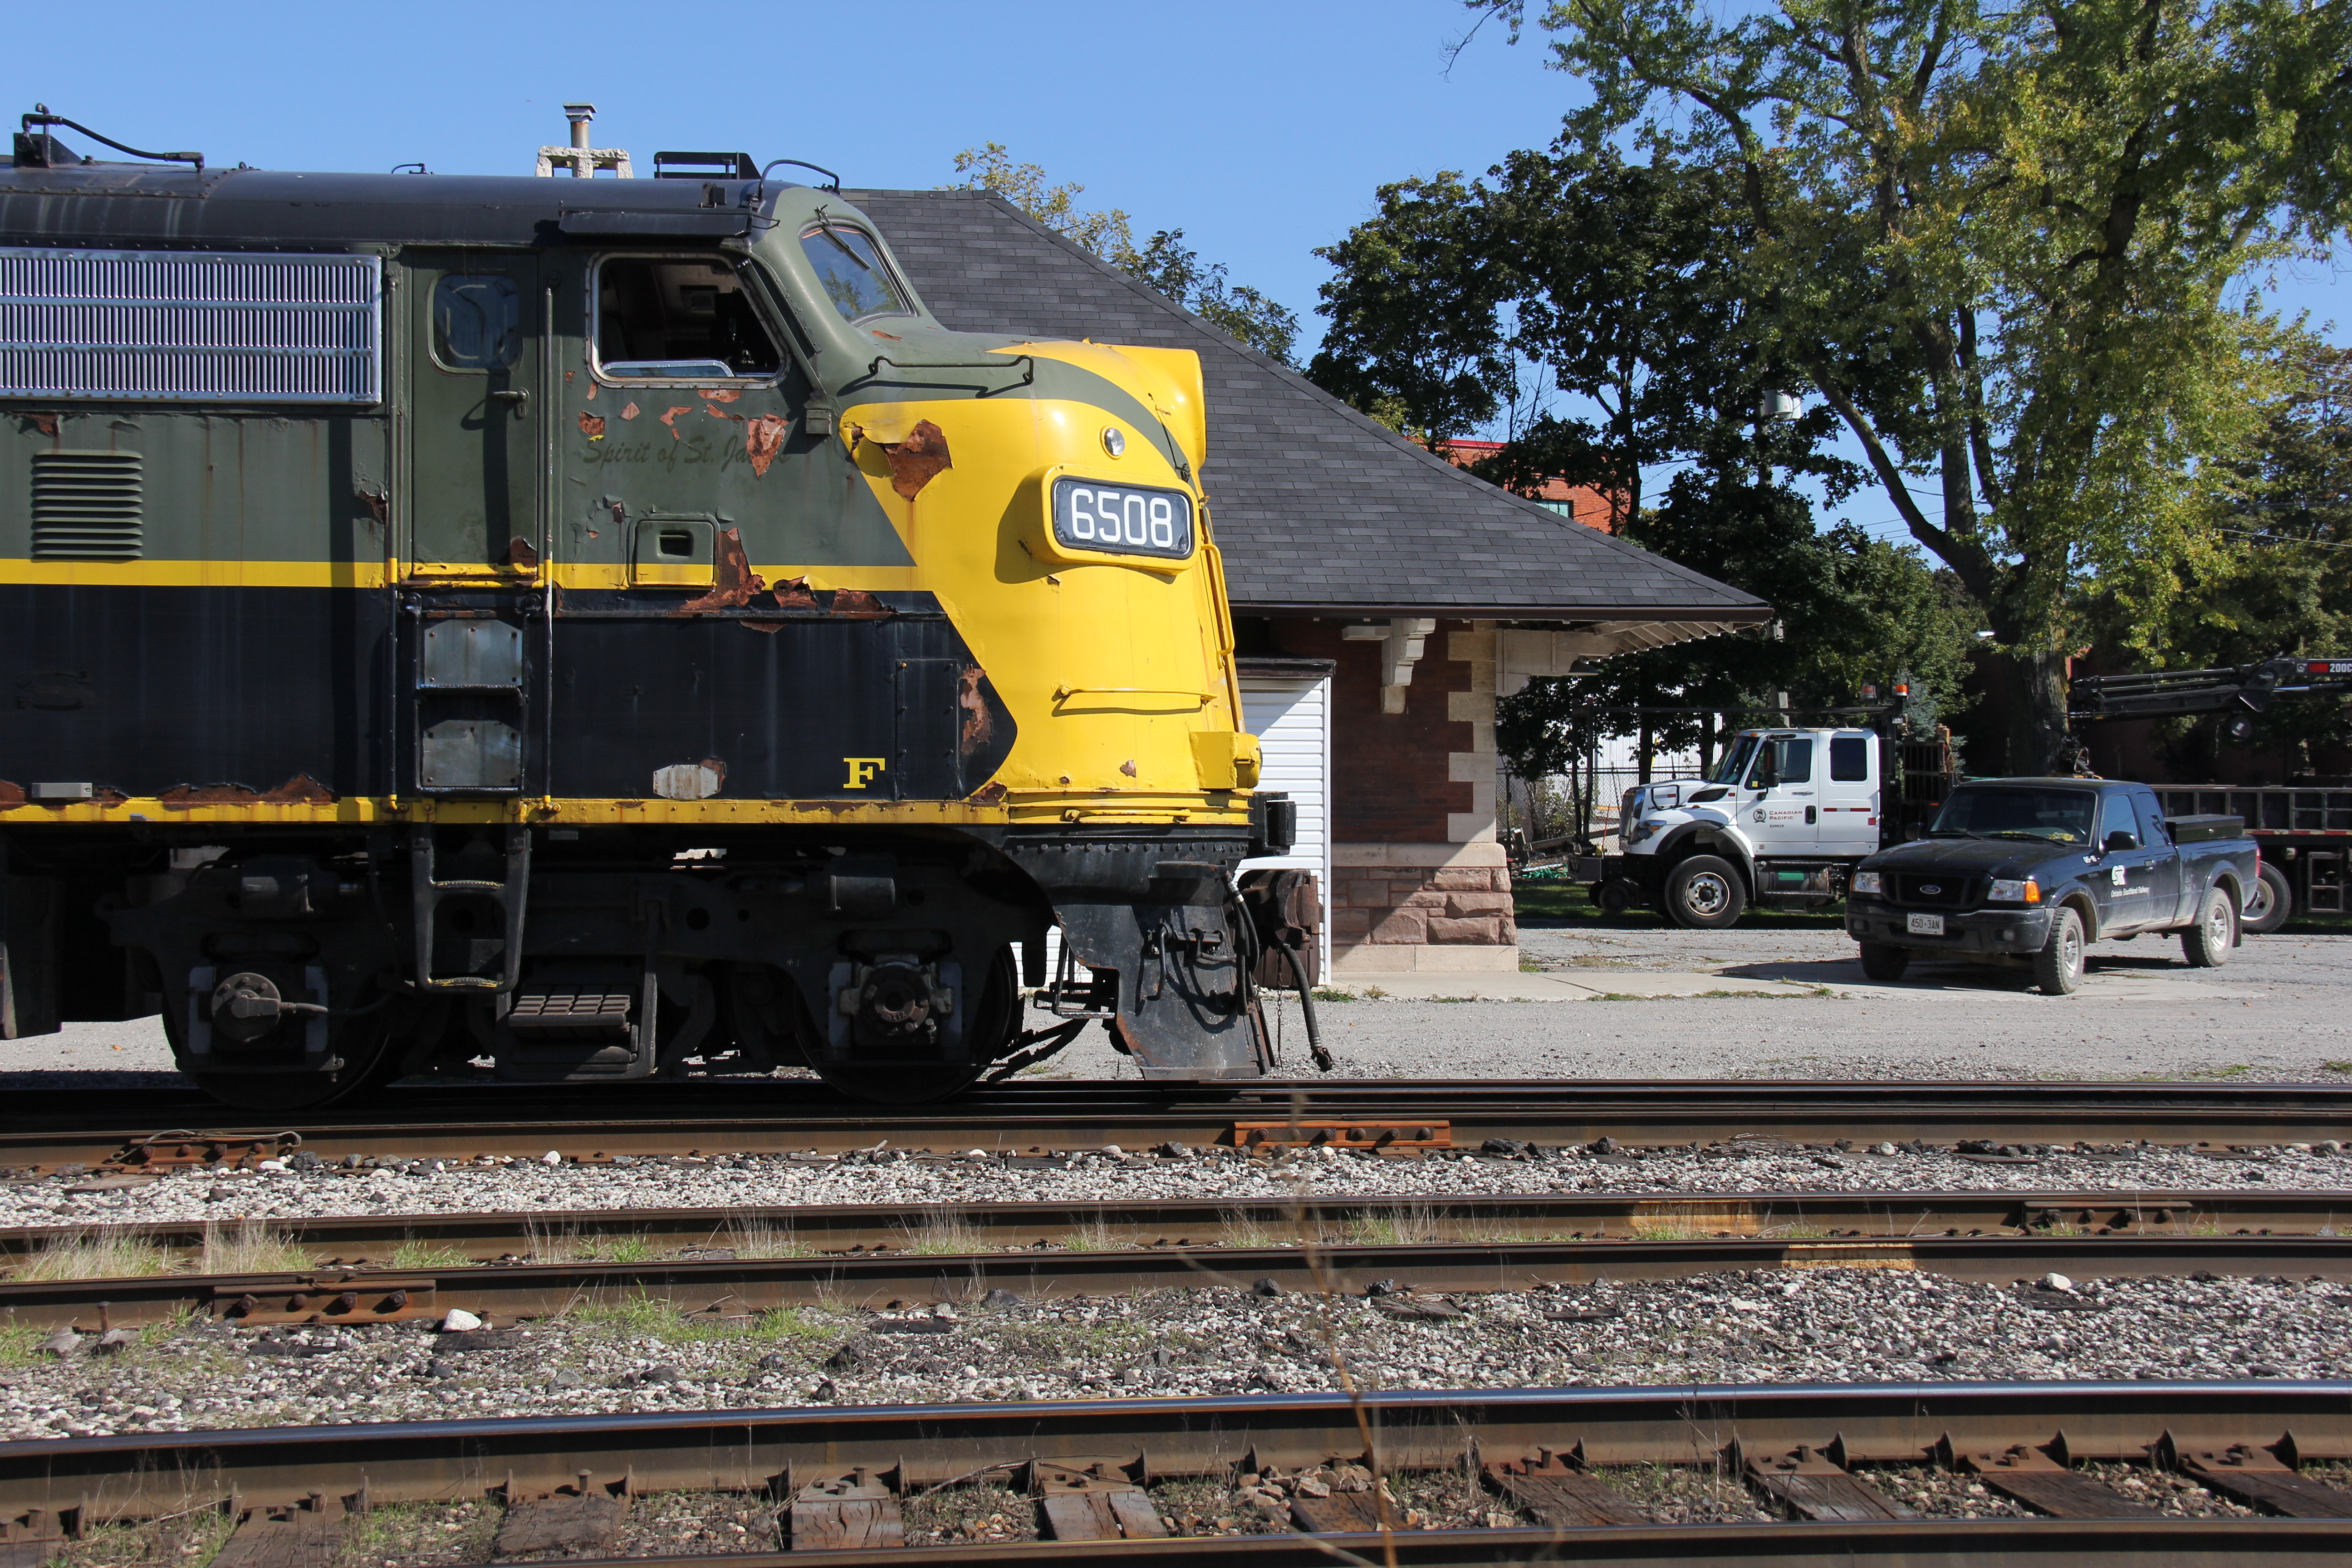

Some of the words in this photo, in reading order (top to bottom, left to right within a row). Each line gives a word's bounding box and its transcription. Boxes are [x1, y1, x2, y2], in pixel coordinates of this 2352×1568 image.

[583, 440, 652, 470] Spirit
[658, 438, 680, 473] of
[1071, 488, 1173, 547] 6508
[843, 758, 885, 788] F
